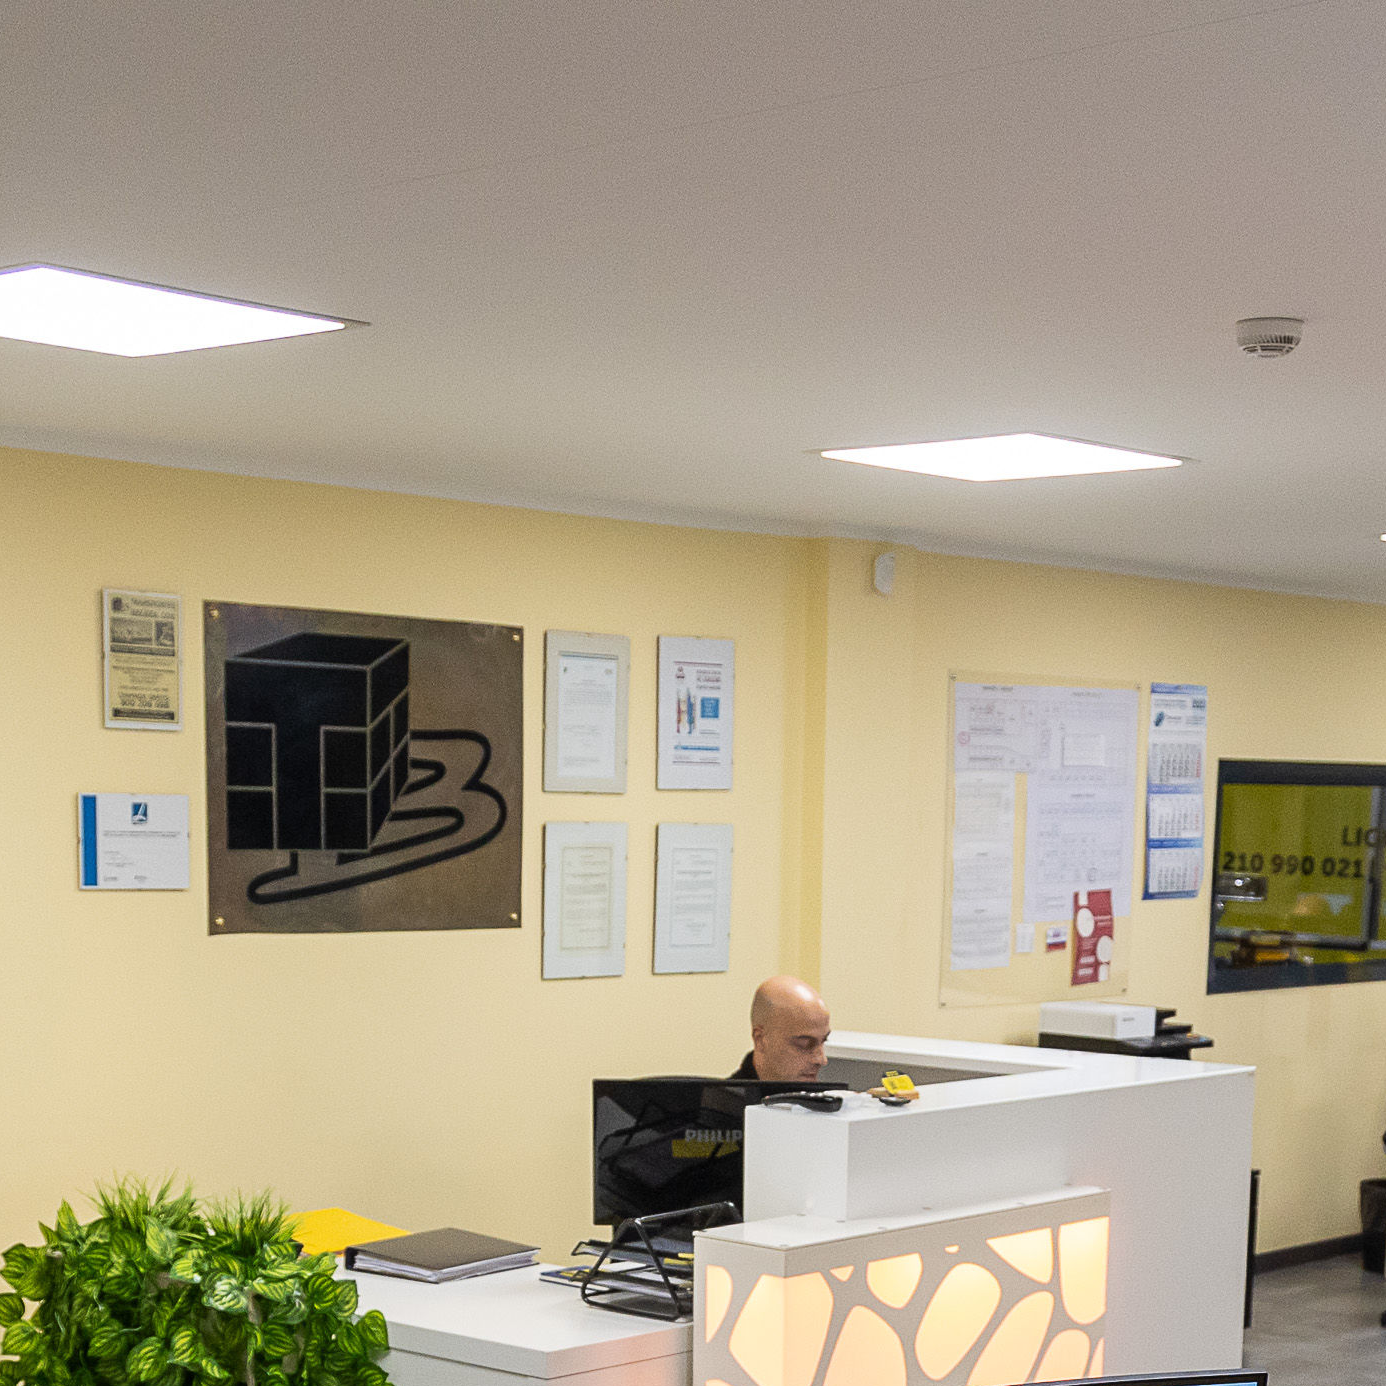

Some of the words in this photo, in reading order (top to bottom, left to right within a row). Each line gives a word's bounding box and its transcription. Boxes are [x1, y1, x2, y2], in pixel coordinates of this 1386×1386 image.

[1223, 851, 1263, 872] 210
[1271, 854, 1315, 876] 990
[1322, 857, 1364, 878] 021
[684, 1128, 743, 1142] PHILIP
